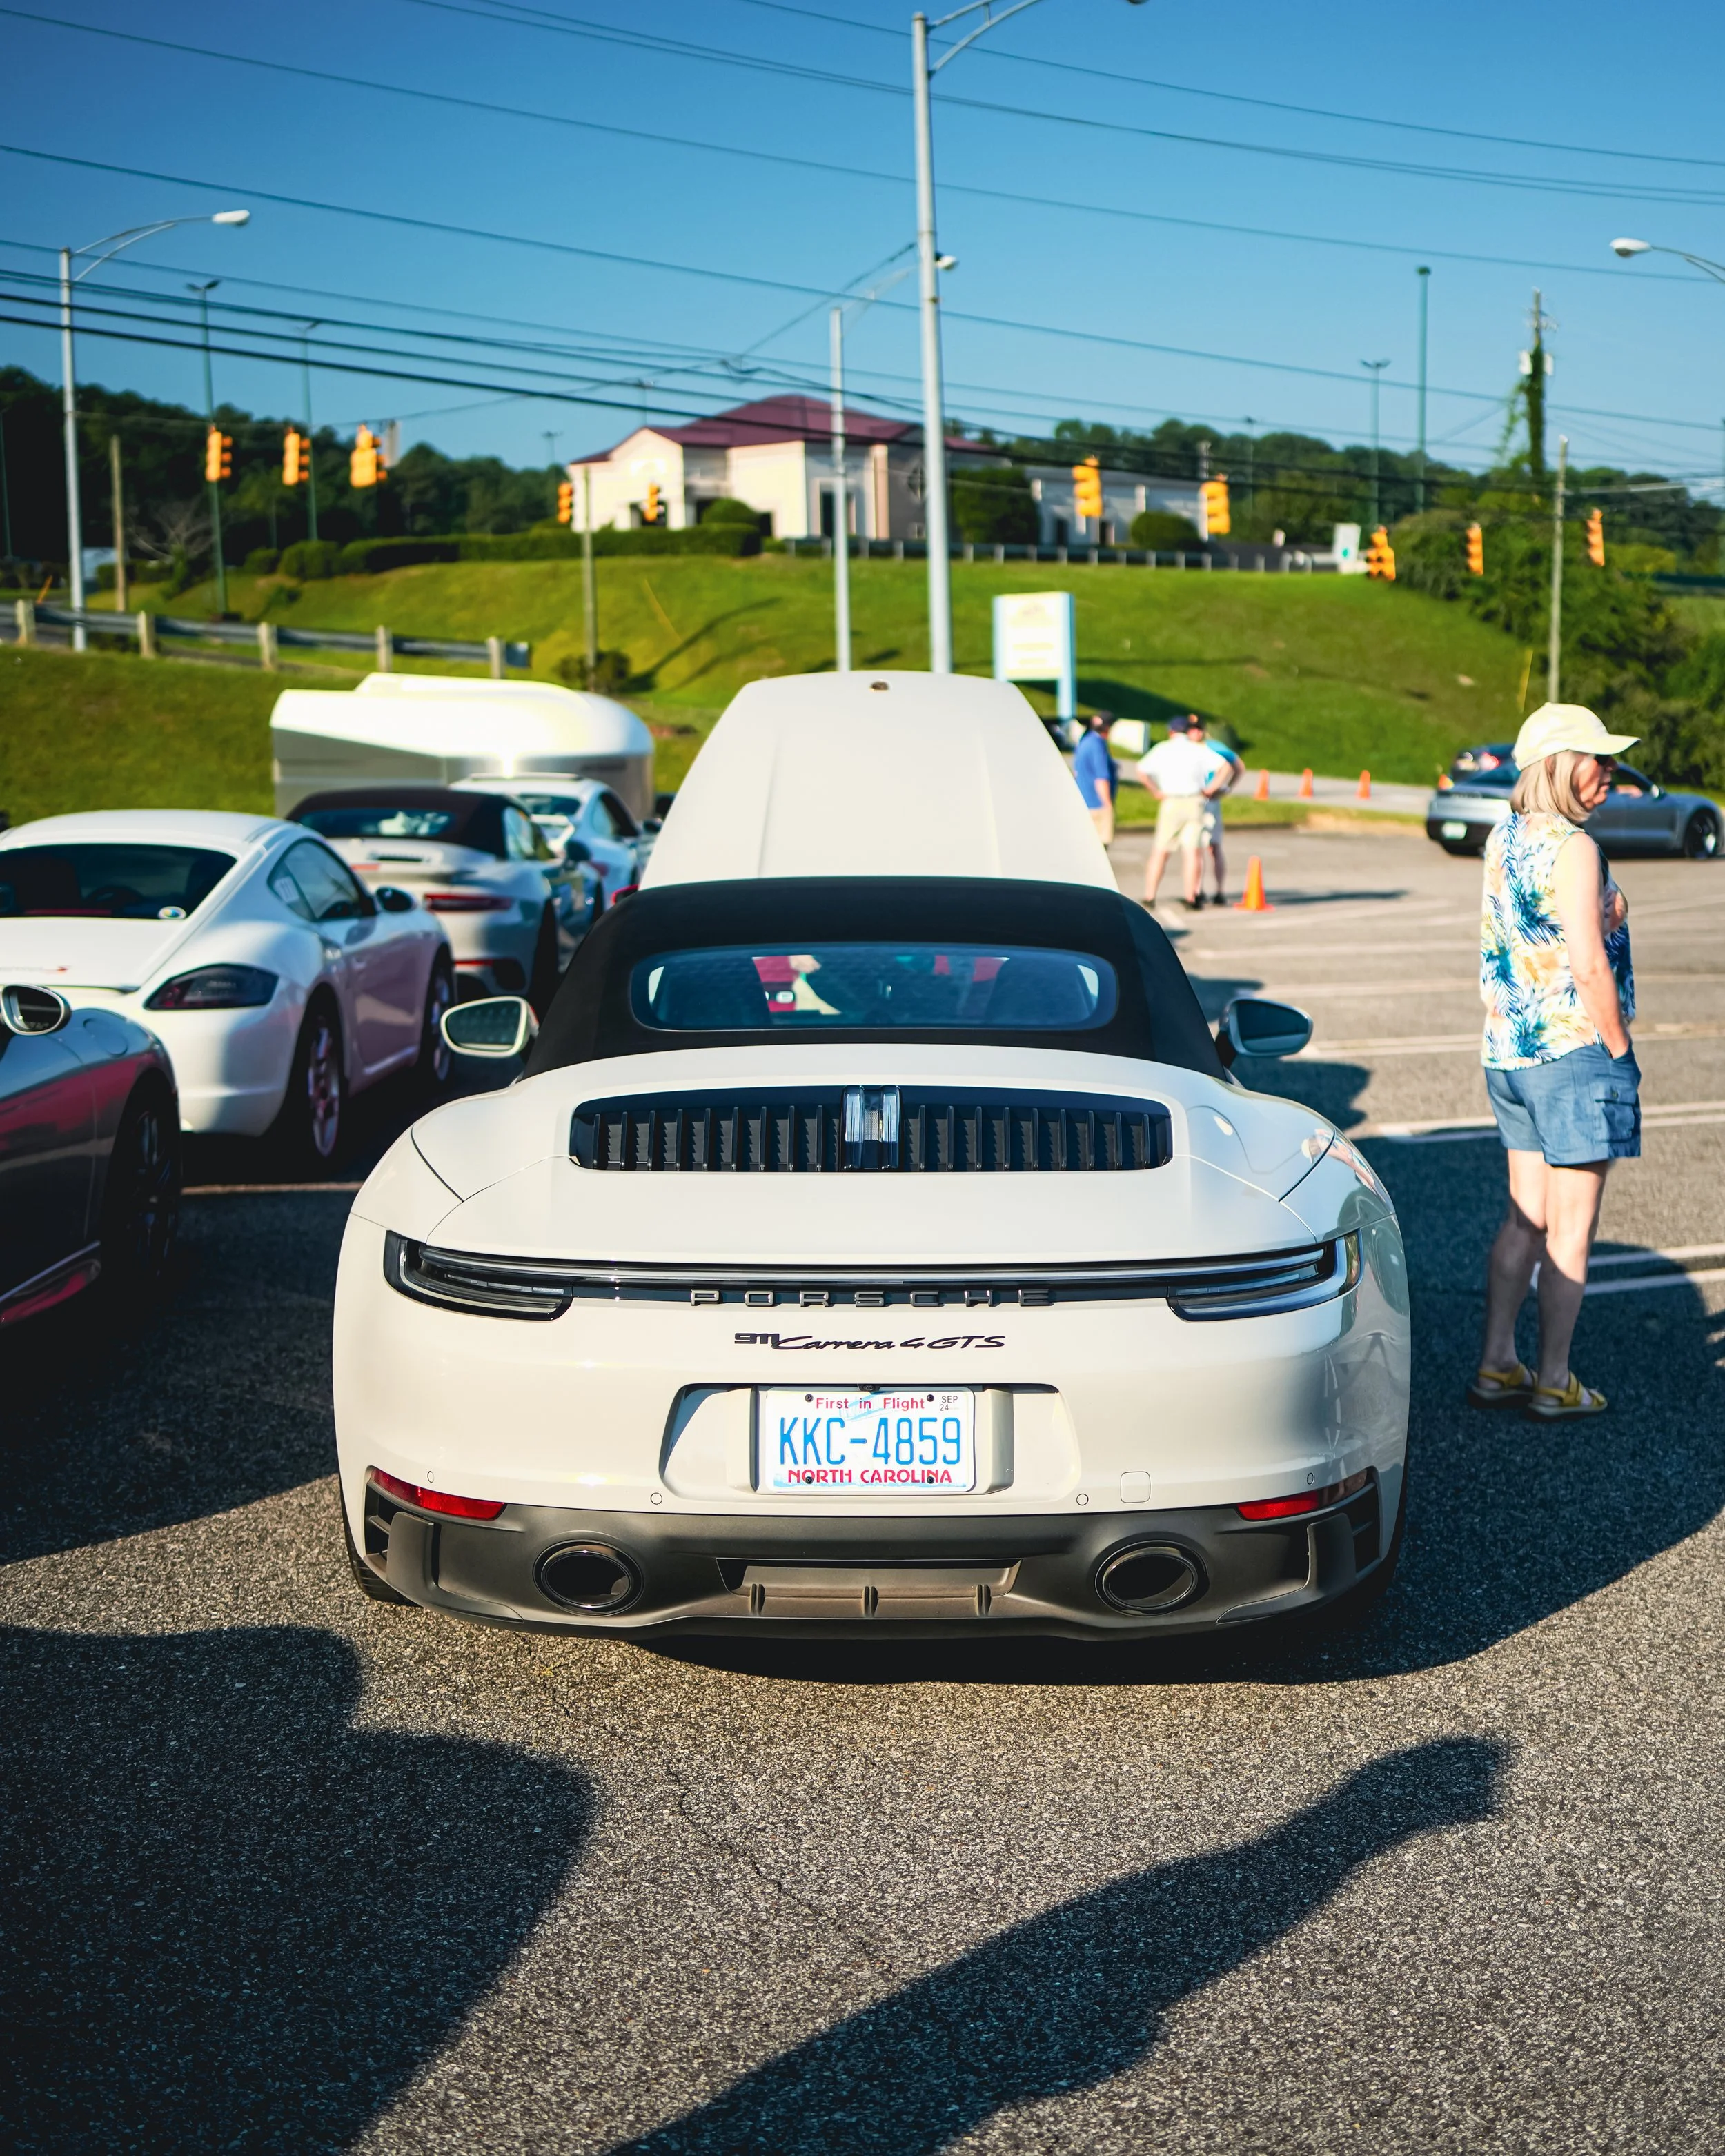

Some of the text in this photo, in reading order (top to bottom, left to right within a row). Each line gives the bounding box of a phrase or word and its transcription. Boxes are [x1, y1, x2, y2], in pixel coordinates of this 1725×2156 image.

[691, 1289, 1049, 1307] PORSCHE
[734, 1333, 1005, 1349] 911 Carrera 4 GTS
[816, 1398, 925, 1411] First in Flight
[780, 1417, 960, 1465] KKC-4859
[788, 1469, 952, 1483] NORTH CAROLINA
